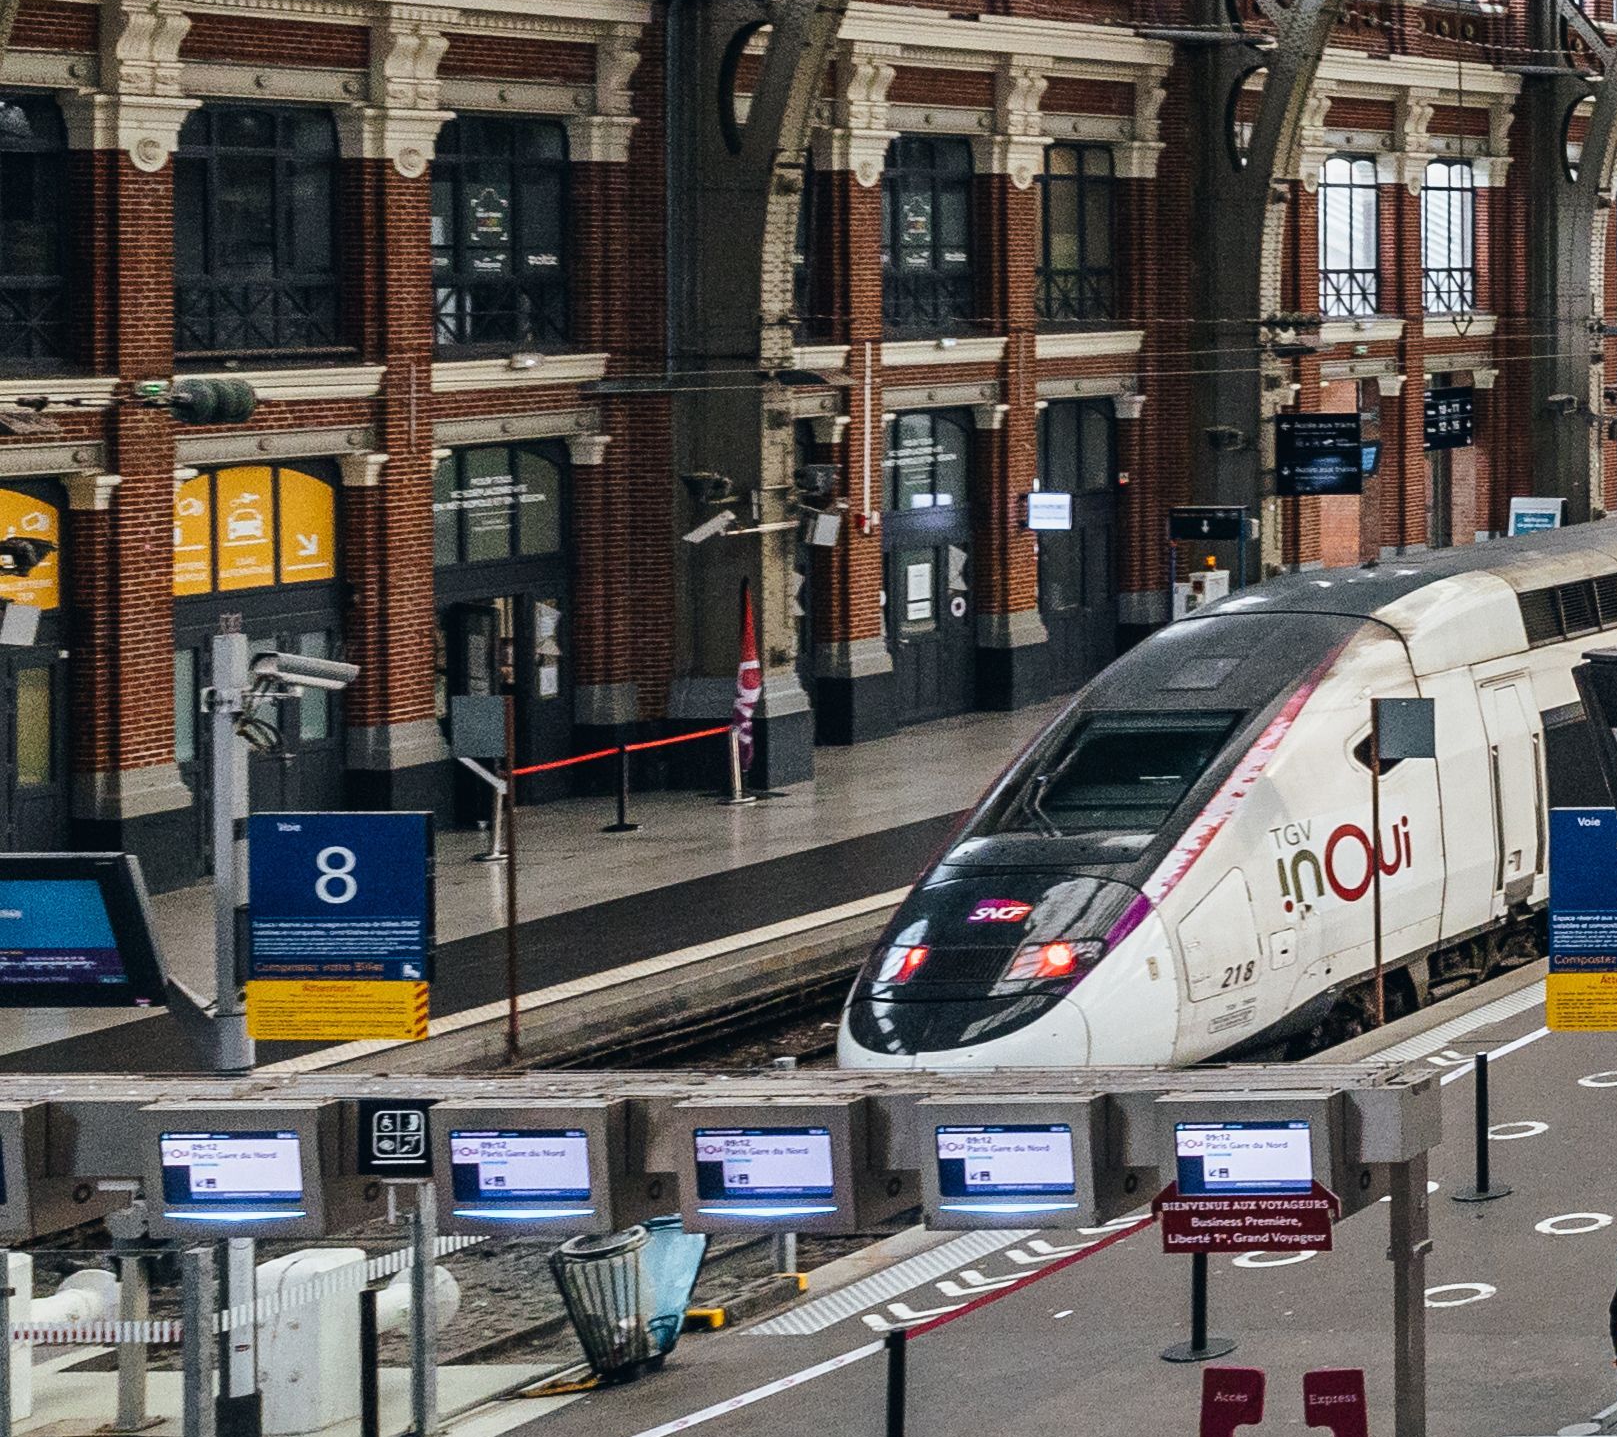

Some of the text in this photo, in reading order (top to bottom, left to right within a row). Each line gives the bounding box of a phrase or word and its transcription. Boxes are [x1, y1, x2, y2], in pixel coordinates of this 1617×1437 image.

[1577, 817, 1601, 827] Voie
[1270, 820, 1312, 848] TGV
[315, 846, 358, 904] 8
[970, 904, 1030, 922] SNCF
[1553, 954, 1617, 966] Compostez
[1221, 959, 1256, 989] 218
[1205, 1141, 1229, 1150] Paris
[1229, 1141, 1252, 1150] Gare
[1266, 1140, 1289, 1149] Nord
[1161, 1200, 1330, 1212] BIENVENUE AUX VOYAGEURS
[1191, 1216, 1303, 1228] Business Première,
[1168, 1233, 1212, 1244] Liberté
[1233, 1233, 1270, 1243] Grand
[1271, 1232, 1327, 1245] Voyageur
[1213, 1391, 1249, 1403] Accès
[1308, 1392, 1358, 1406] Express
